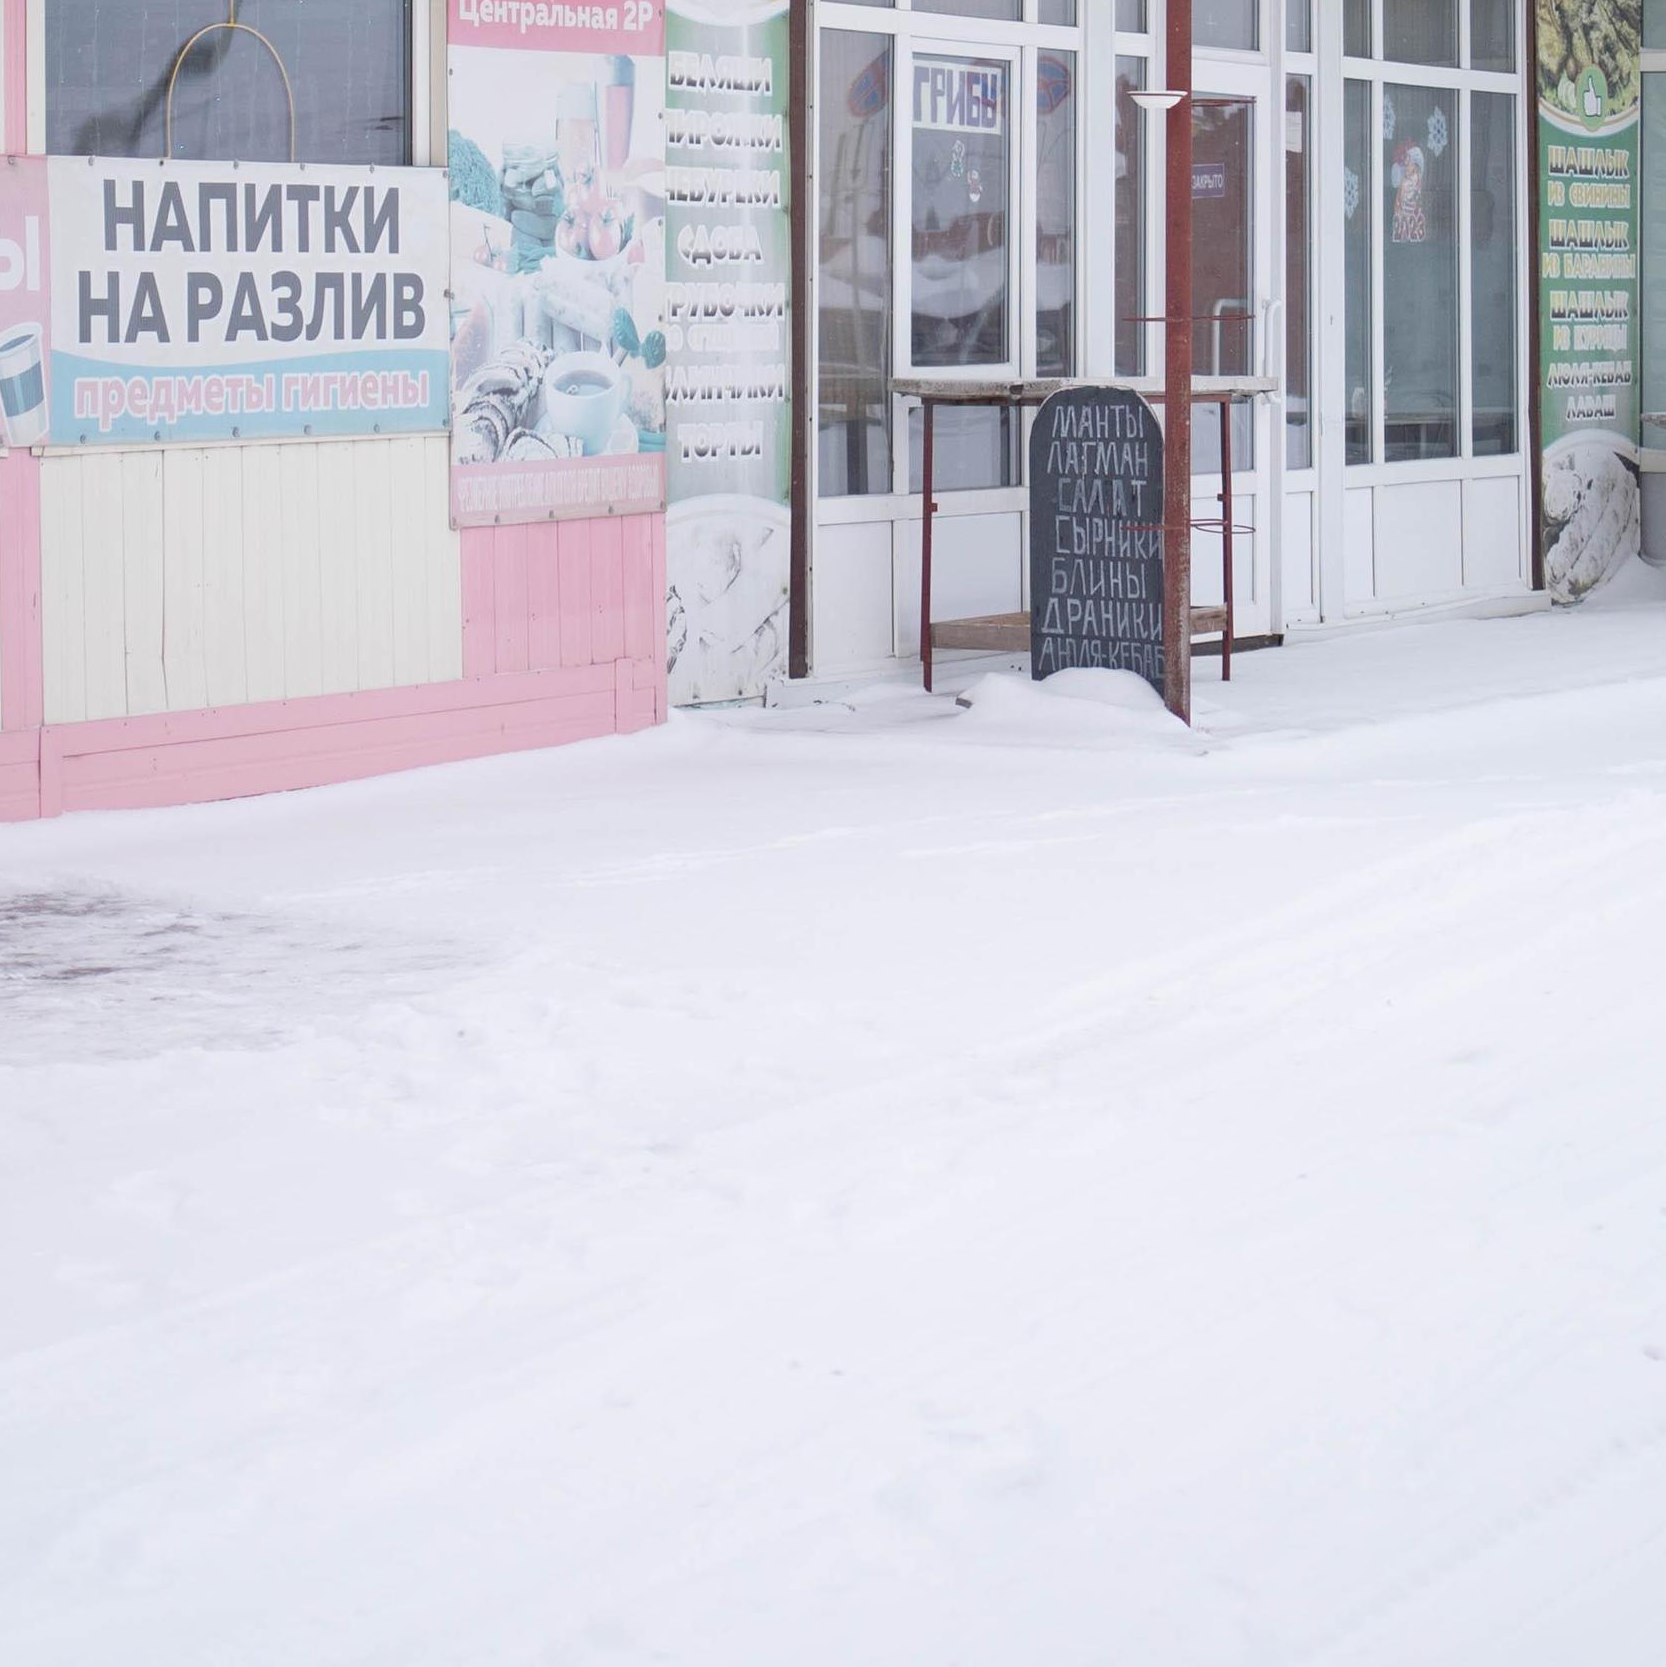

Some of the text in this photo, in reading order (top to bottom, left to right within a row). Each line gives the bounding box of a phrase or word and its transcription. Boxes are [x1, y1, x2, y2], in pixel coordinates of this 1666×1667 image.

[669, 51, 773, 96] БЕЛЯШИ
[1548, 145, 1630, 179] ШАШЛЫК
[1548, 181, 1630, 209] ИЗ СВИНИНЫ
[103, 178, 400, 254] НАПИТКИ
[1549, 219, 1629, 252] ШАШЛЫК
[677, 225, 763, 269] СДОБА
[1542, 252, 1636, 279] ИЗ БАРАНИНЫ
[78, 269, 427, 344] НА РАЗЛИВ
[666, 282, 785, 323] РУБОЧКИ
[1550, 290, 1629, 322] ШАШЛЫК
[1553, 325, 1571, 350] ИЗ
[1547, 361, 1632, 389] ЛЮЛЯ-КЕБАБ
[73, 367, 430, 431] предметы гигиены
[1566, 394, 1616, 421] ЛАВАШ
[1052, 405, 1144, 438] МАНТЫ
[677, 421, 764, 463] ТОРТЫ
[1047, 441, 1148, 477] ЛАГМАН
[1058, 477, 1147, 517] САЛАТ
[1055, 515, 1163, 560] СЫРНИКИ
[1052, 557, 1146, 599] БЛИНЫ
[1041, 597, 1163, 641] ДРАНИКИ
